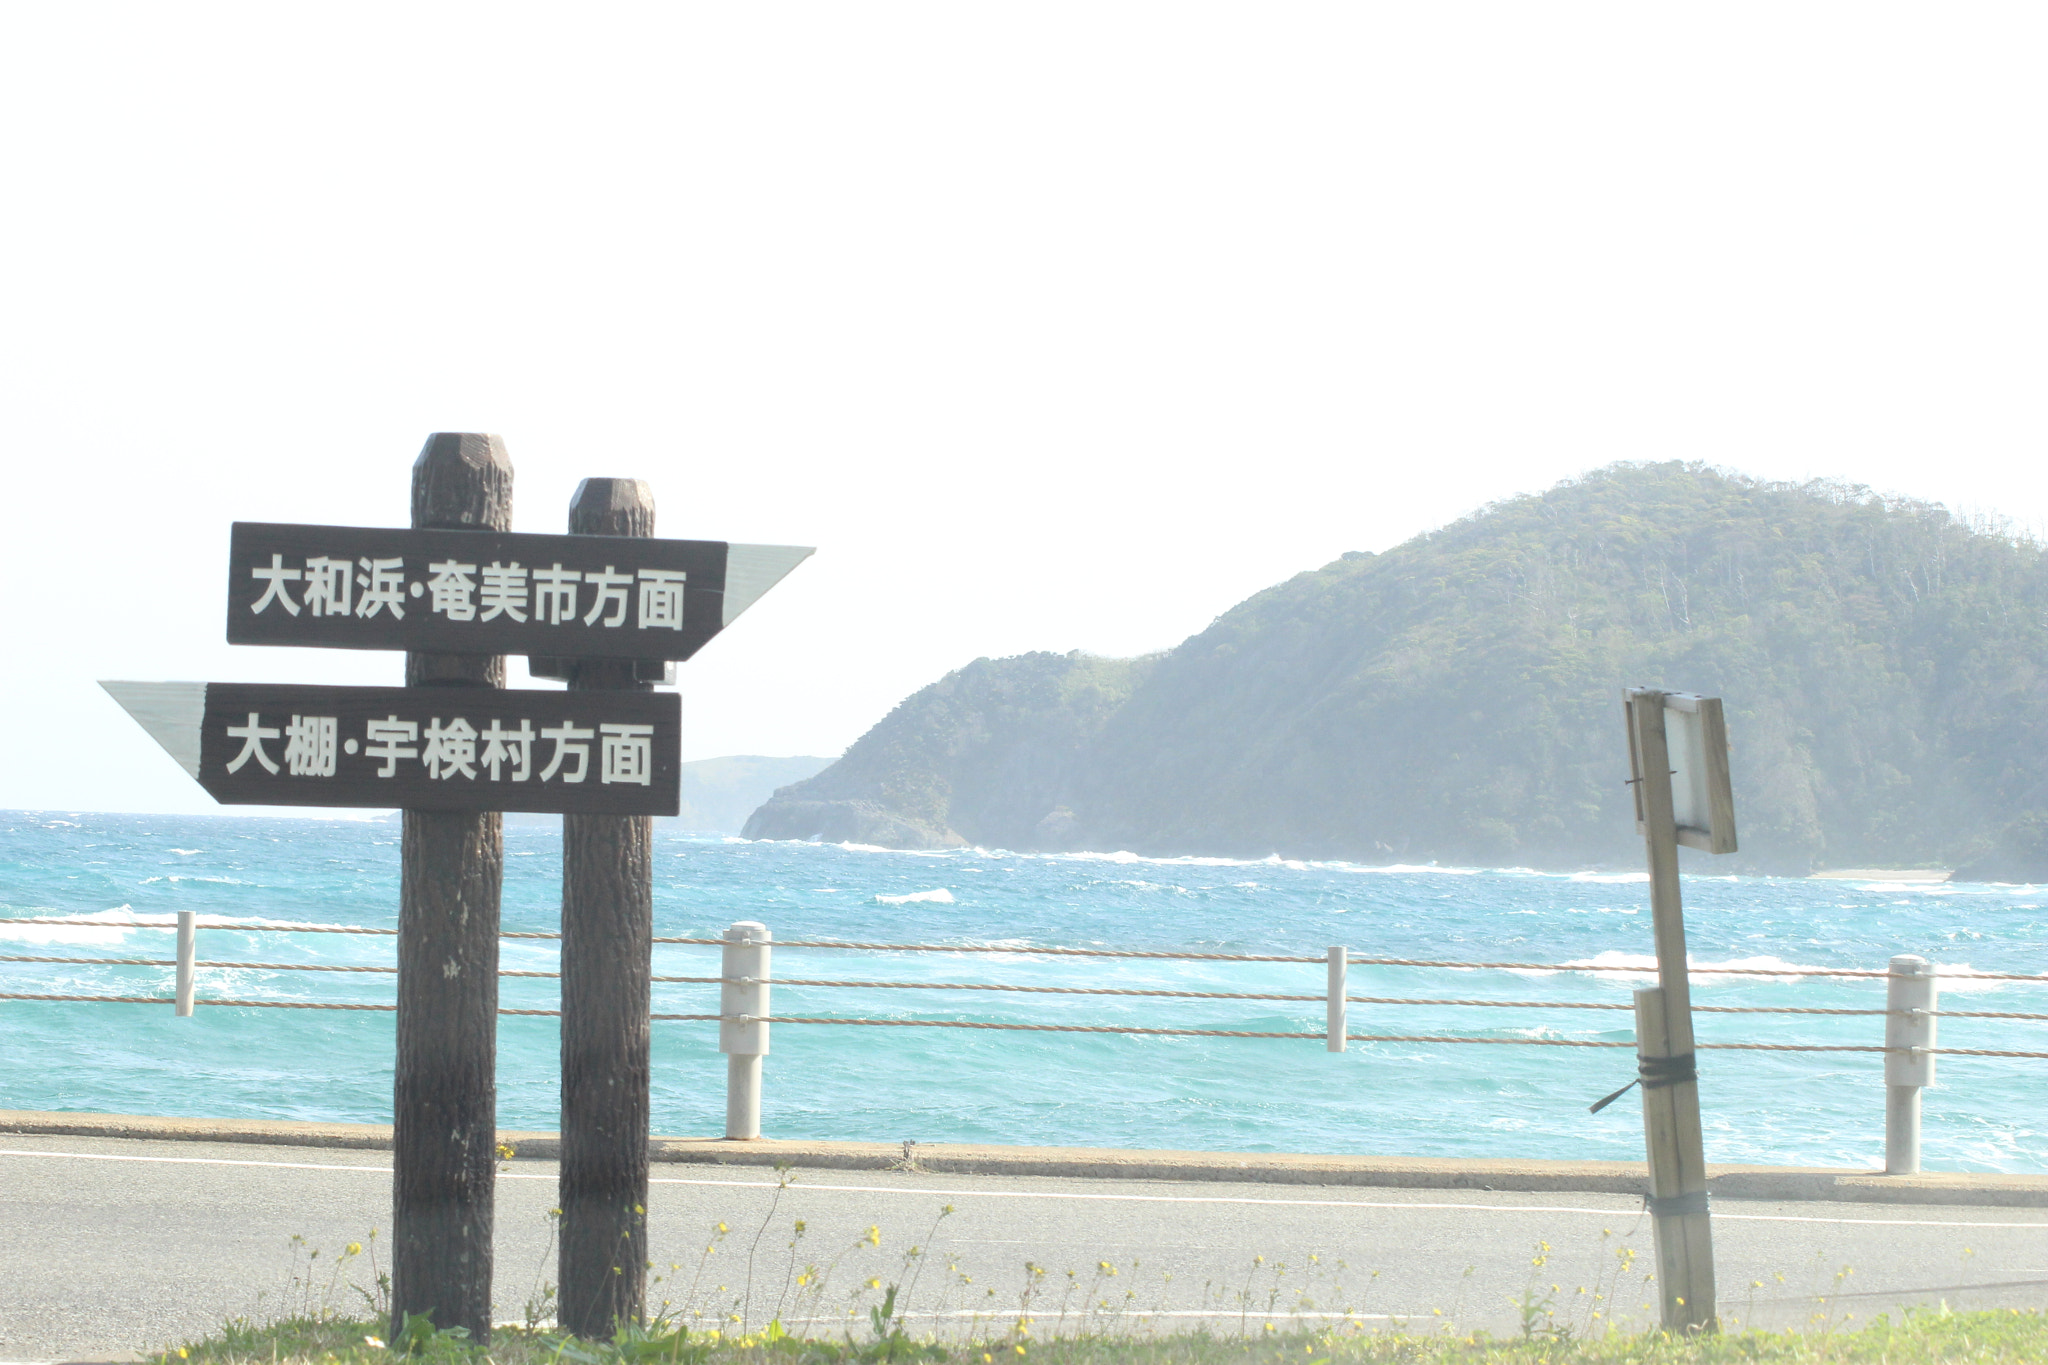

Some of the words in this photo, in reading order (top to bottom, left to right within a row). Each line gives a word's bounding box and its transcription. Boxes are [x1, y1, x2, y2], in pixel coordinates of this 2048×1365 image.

[250, 553, 687, 631] 大和浜・奄美市方面
[226, 712, 654, 786] 大棚・宇検村方面
